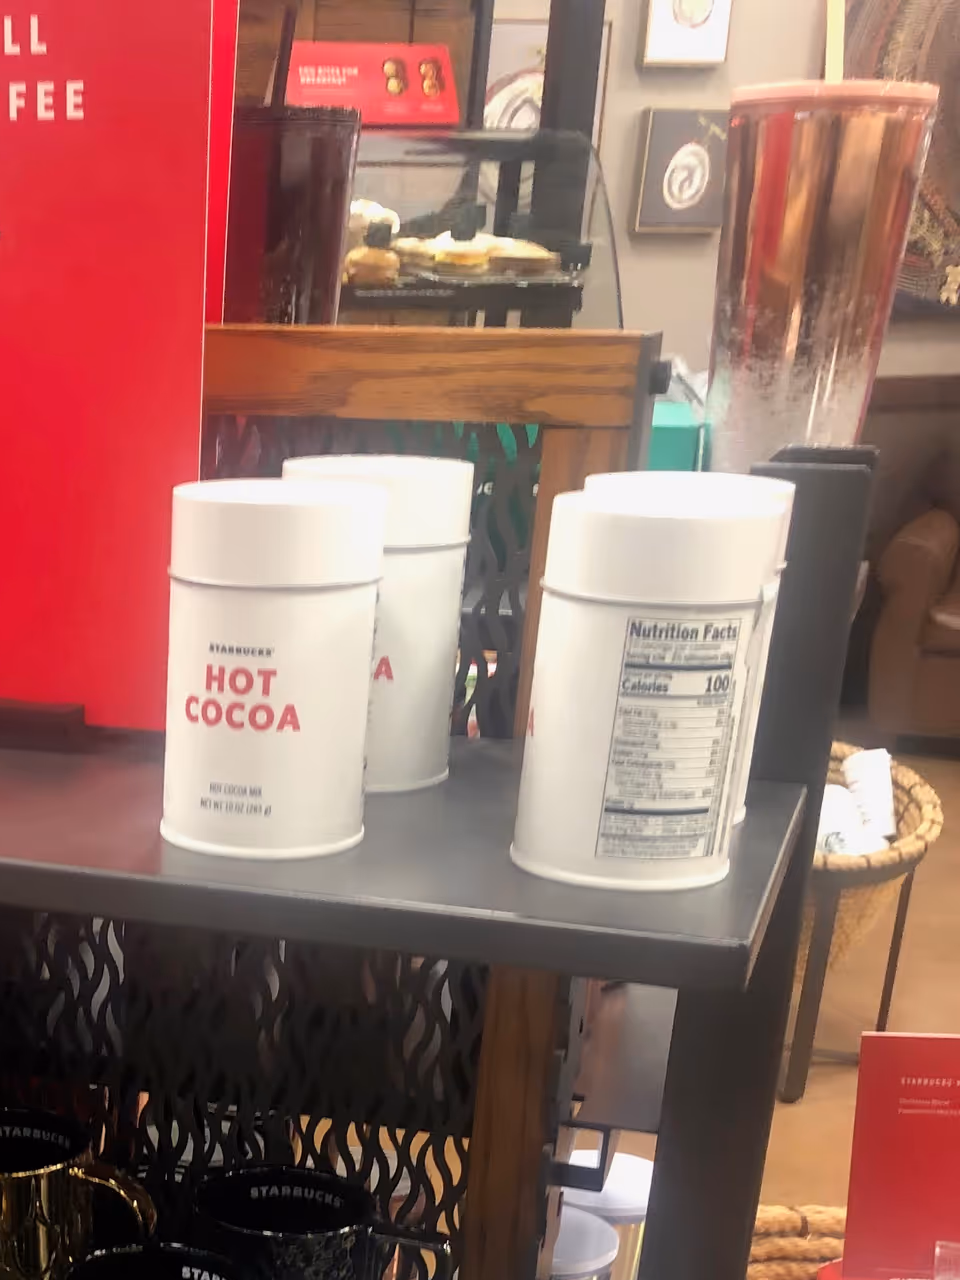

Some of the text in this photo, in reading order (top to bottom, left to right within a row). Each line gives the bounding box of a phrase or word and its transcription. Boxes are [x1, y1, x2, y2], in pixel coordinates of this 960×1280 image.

[630, 621, 738, 640] Nutrition Facts
[209, 642, 272, 657] STARBUCKS
[205, 663, 277, 697] HOT
[621, 674, 730, 693] Calories 100
[185, 695, 300, 733] COCOA
[250, 1185, 340, 1208] STARBUCKS
